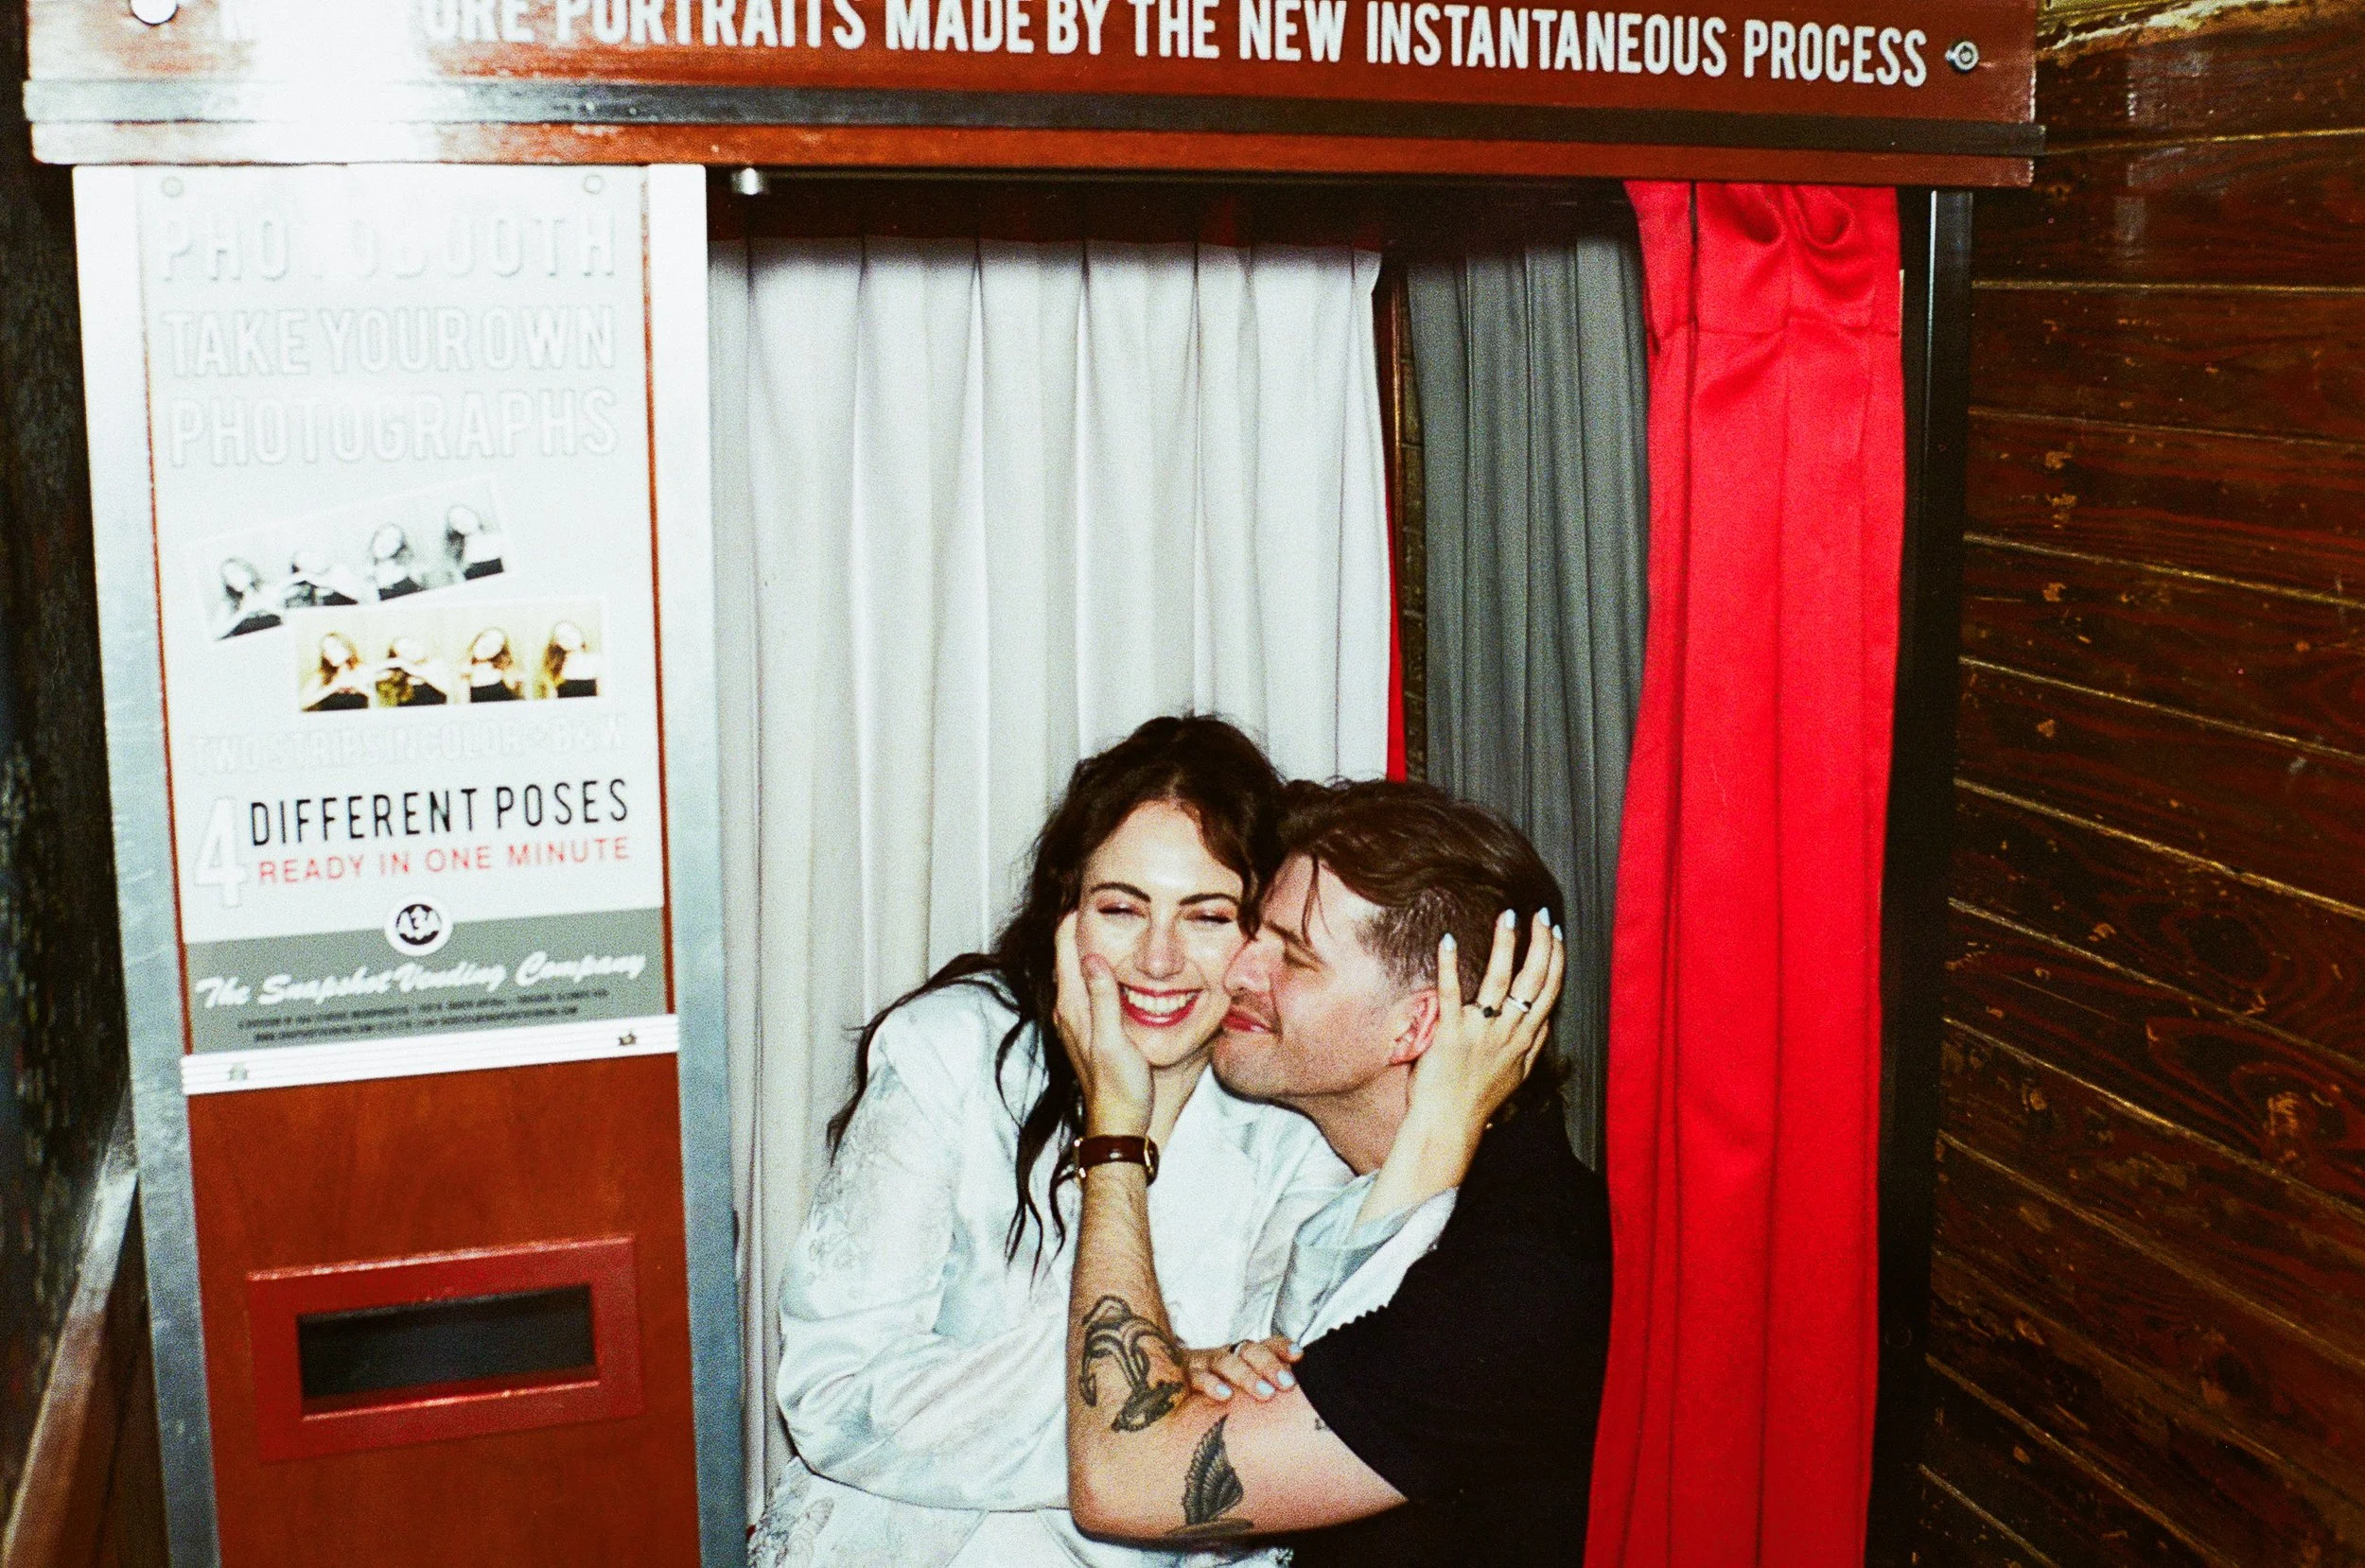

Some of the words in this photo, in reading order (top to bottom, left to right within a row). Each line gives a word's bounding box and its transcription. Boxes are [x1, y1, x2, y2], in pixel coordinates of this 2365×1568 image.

[552, 0, 867, 50] PORTRAITS
[885, 0, 1034, 54] MADE
[1047, 0, 1110, 55] BY
[1127, 0, 1220, 59] THE
[1239, 0, 1347, 62] NEW
[1366, 1, 1727, 78] INSTANTANEOUS
[1743, 19, 1927, 87] PROCESS
[158, 210, 616, 282] PHOOBOOTH
[162, 308, 310, 377] TAKE
[317, 305, 472, 375] YOUR
[480, 305, 616, 371] OWN
[168, 386, 618, 468] PHOTOGRAPHS
[193, 795, 248, 909] 4
[250, 788, 478, 847] DIFFERENT
[495, 778, 628, 828] POSES
[257, 855, 365, 885] READY
[380, 852, 410, 875] IN
[425, 845, 492, 873] ONE
[507, 836, 631, 866] MINUTE
[195, 976, 251, 1008] The
[257, 965, 393, 1005] Snapshot
[392, 961, 507, 993] Vending
[516, 950, 646, 986] Company
